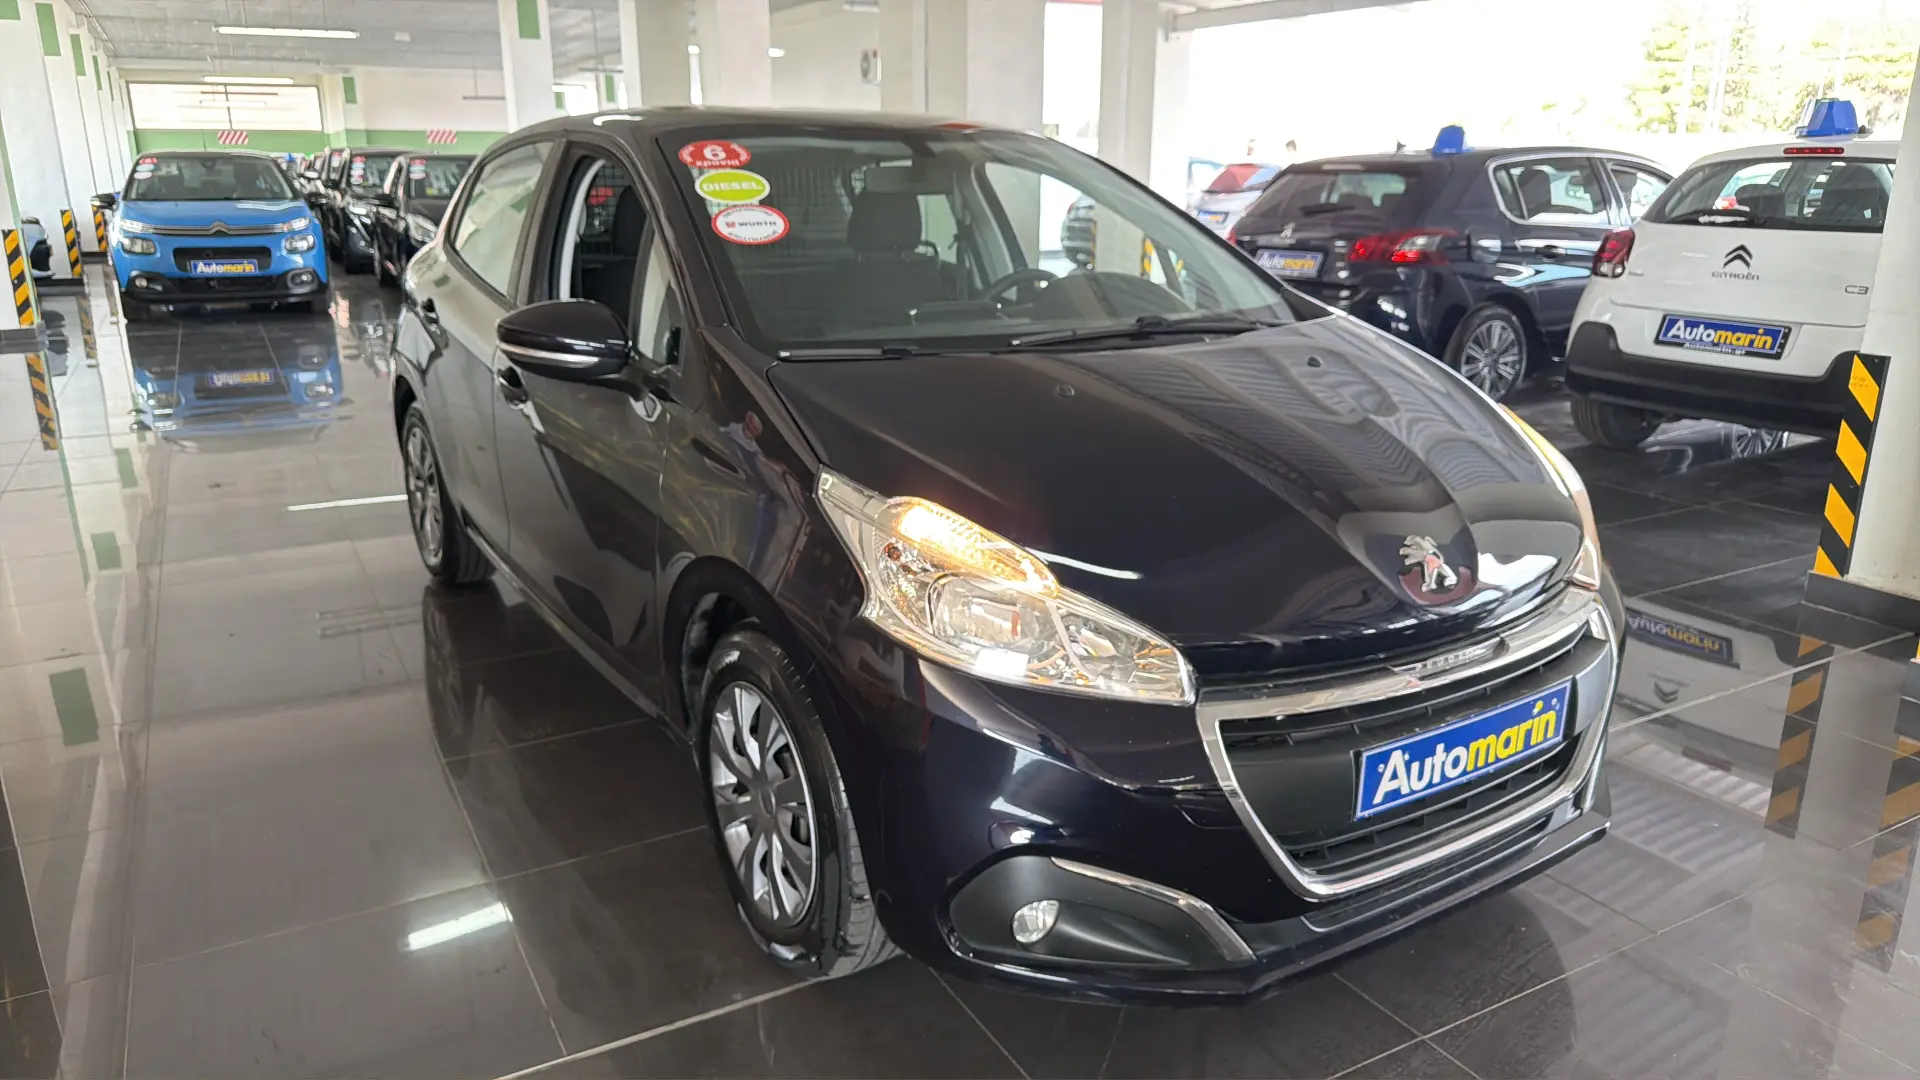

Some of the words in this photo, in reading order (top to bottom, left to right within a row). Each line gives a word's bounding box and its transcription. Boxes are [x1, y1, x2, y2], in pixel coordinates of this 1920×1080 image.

[703, 144, 726, 160] 6
[702, 181, 763, 191] DIESEL
[196, 262, 255, 273] Automarin
[1844, 285, 1869, 295] C3
[1667, 320, 1773, 350] Automarin
[1372, 699, 1557, 805] Automarin
